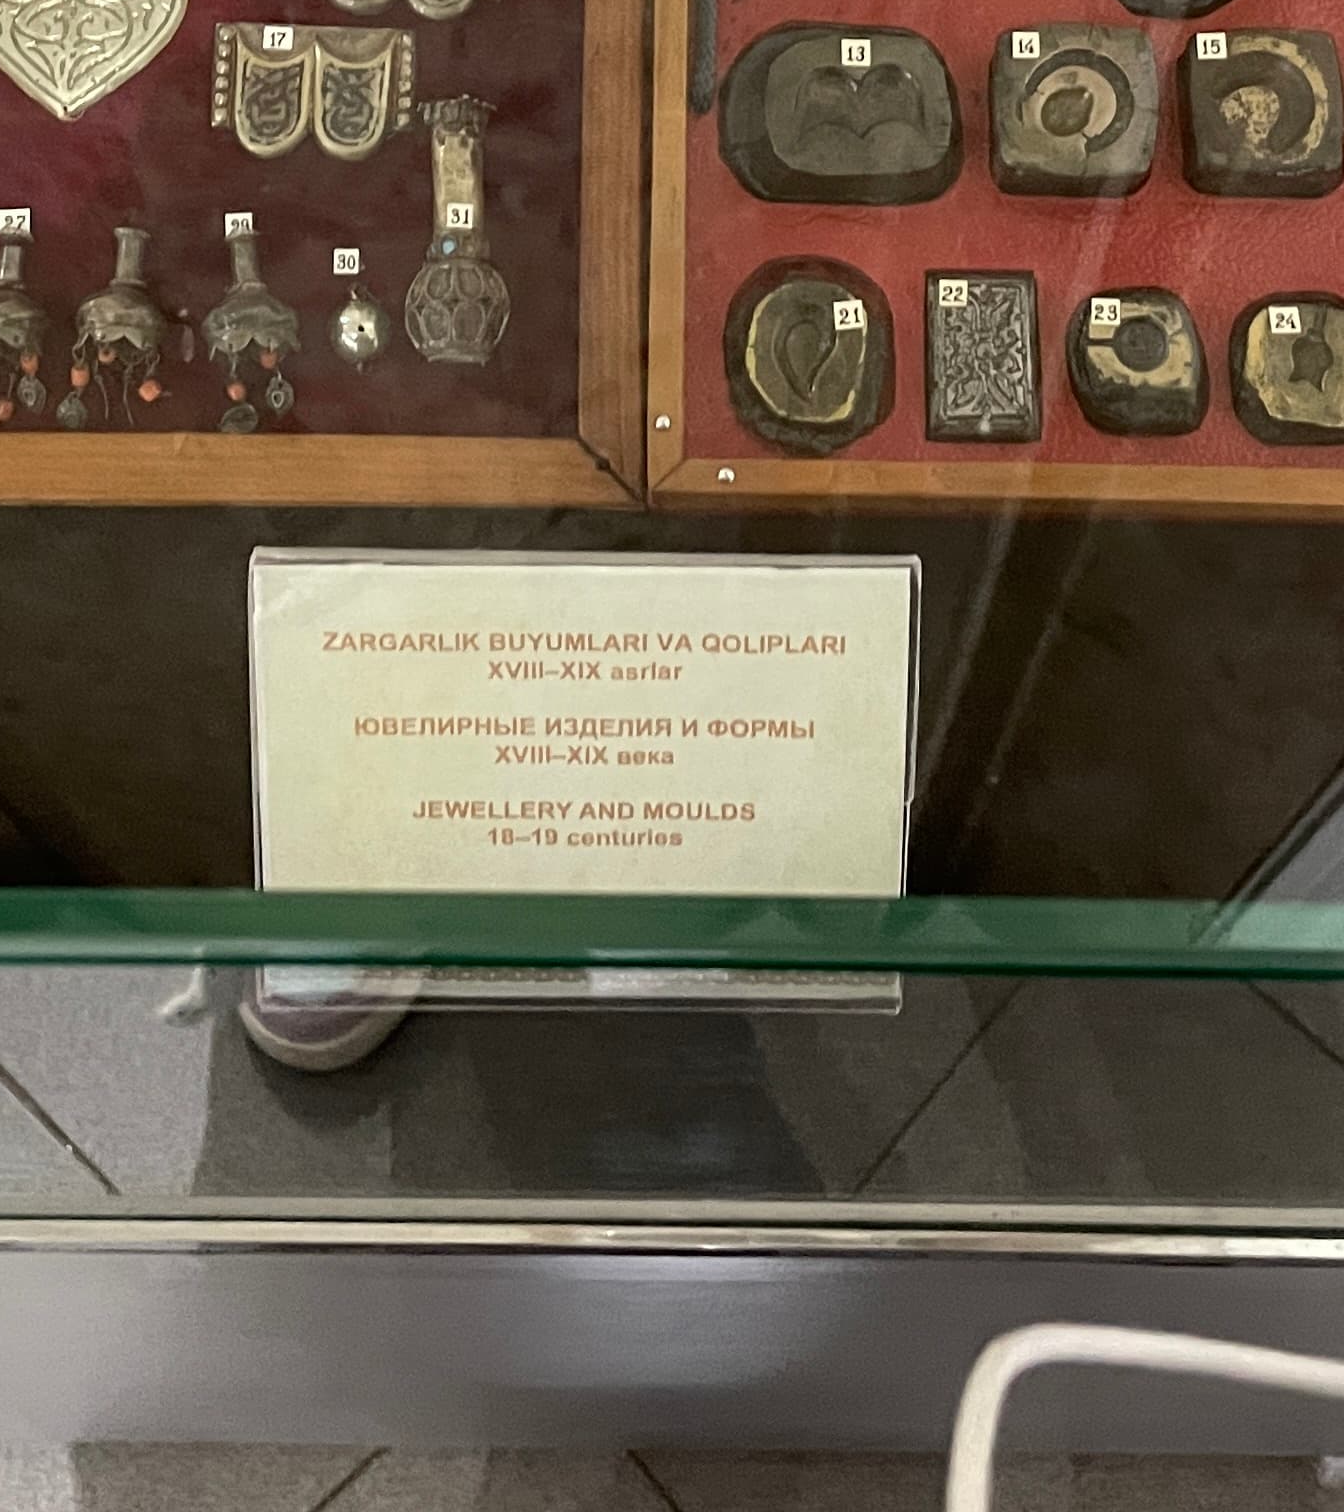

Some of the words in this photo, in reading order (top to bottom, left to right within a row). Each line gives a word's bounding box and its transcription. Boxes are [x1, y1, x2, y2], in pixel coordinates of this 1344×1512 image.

[270, 31, 287, 48] 17
[1018, 38, 1035, 54] 14
[1202, 39, 1221, 56] 15
[847, 45, 865, 62] 13
[3, 215, 27, 231] 27
[451, 208, 469, 225] 31
[336, 253, 356, 271] 30
[942, 286, 964, 303] 22
[839, 306, 861, 326] 21
[1094, 303, 1118, 322] 23
[1275, 312, 1297, 330] 24
[323, 631, 480, 652] ZARGARLIK
[489, 632, 648, 653] BUYUMLARI
[656, 633, 693, 653] VA
[701, 633, 846, 655] QOLIPLARI
[610, 661, 683, 681] asrlar
[354, 717, 536, 737] ЮВЕЛИРНЫЕ
[545, 718, 672, 740] ИЗДЕЛИЯ
[681, 719, 698, 738] И
[707, 719, 815, 740] ФОРМЫ
[617, 750, 674, 766] века
[412, 800, 572, 820] JEWELLERY
[578, 801, 635, 821] AND
[643, 801, 756, 822] MOULDS
[567, 828, 683, 847] centuries
